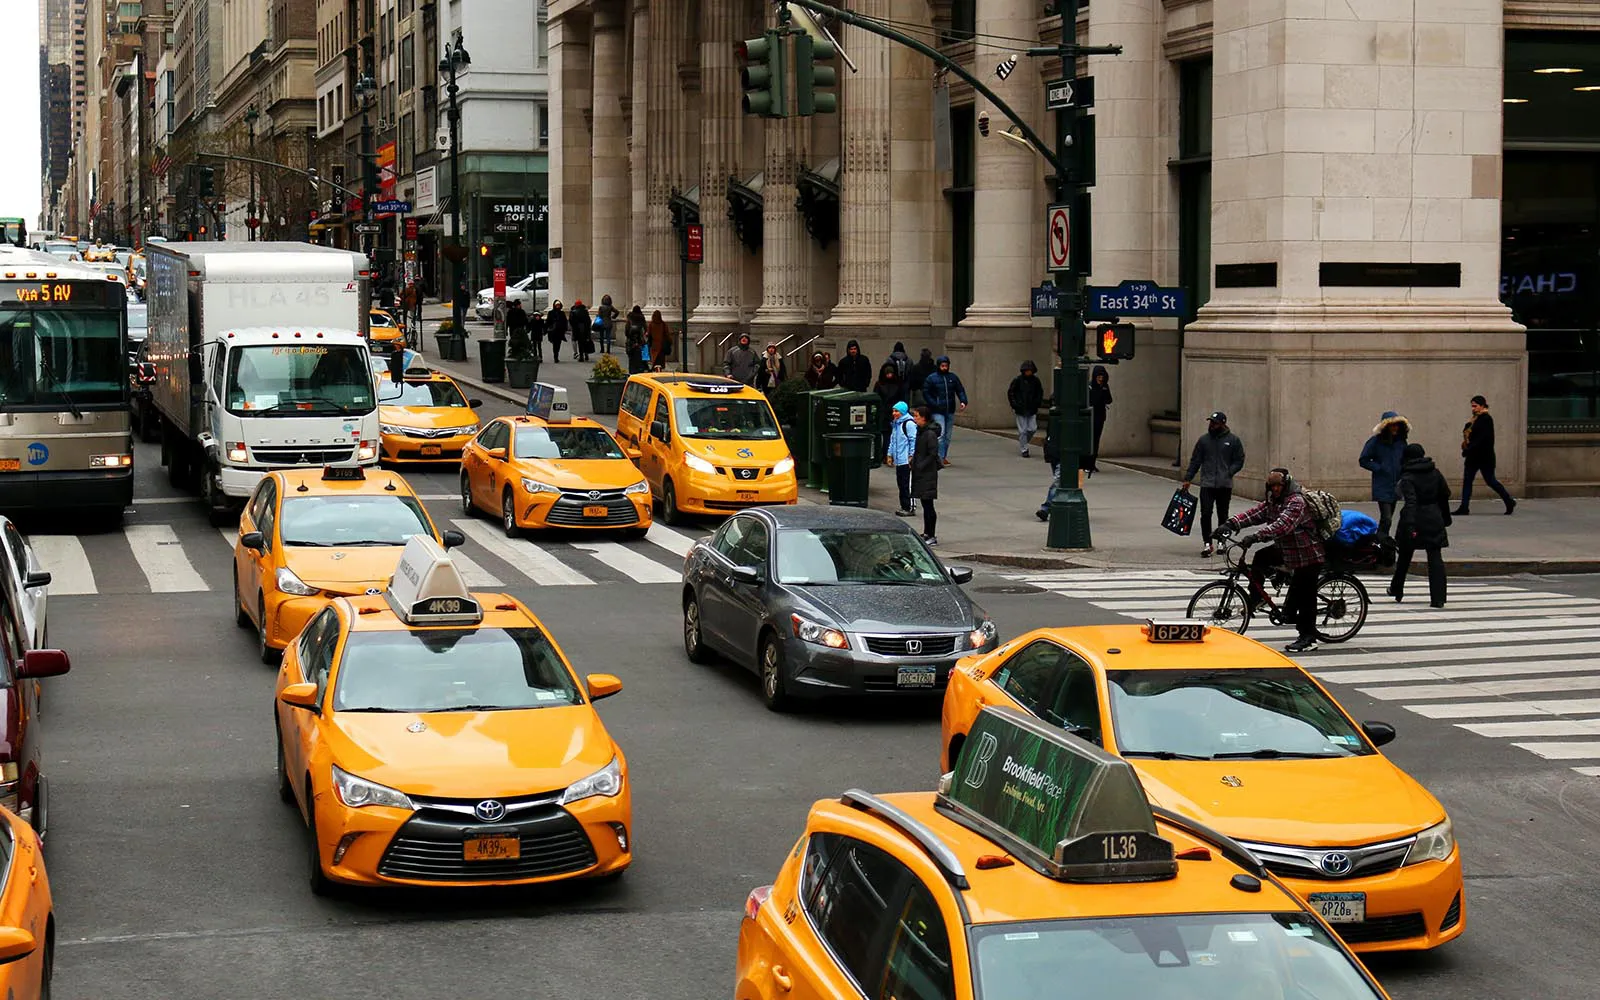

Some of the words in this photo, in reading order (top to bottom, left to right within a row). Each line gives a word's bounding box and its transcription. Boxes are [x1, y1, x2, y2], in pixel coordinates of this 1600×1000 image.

[377, 203, 389, 211] East
[41, 284, 50, 301] 5
[54, 284, 72, 301] AV
[1100, 294, 1129, 310] East
[1132, 293, 1158, 310] 34th
[1161, 295, 1176, 310] St
[28, 447, 45, 461] MTA
[428, 599, 462, 613] 4K39
[1158, 625, 1199, 640] 6P28
[1002, 755, 1045, 790] Brookfield
[1041, 775, 1063, 800] Place
[1102, 835, 1137, 860] 1L36
